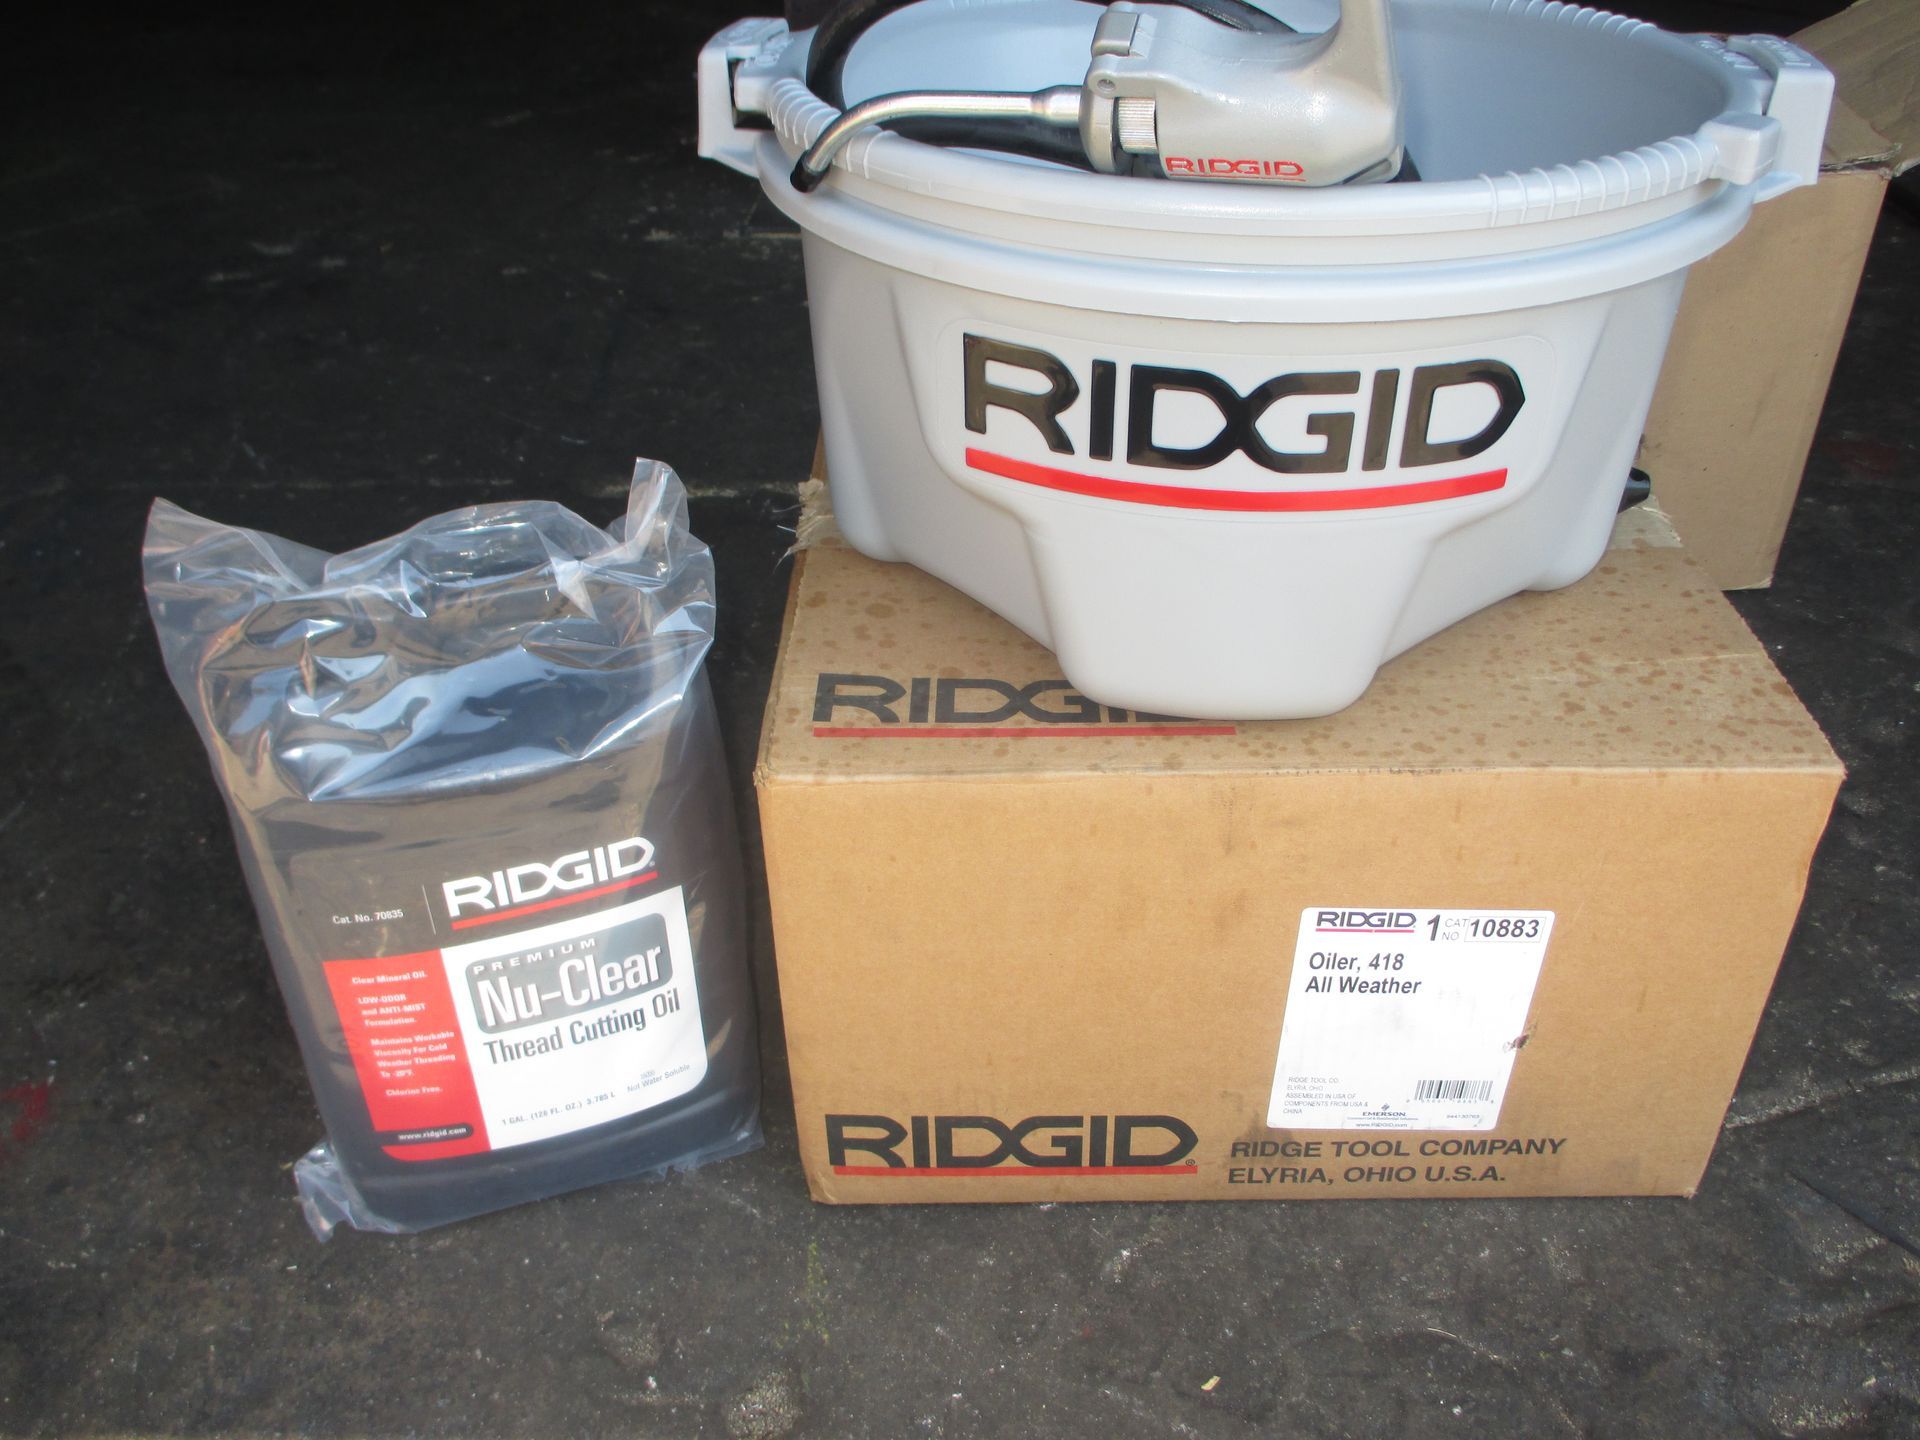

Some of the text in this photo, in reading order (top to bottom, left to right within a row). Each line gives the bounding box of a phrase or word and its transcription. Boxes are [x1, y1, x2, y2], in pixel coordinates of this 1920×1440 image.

[1165, 157, 1304, 178] RIDGID
[963, 332, 1526, 474] RIDGID
[812, 672, 1202, 724] RIDG
[443, 836, 655, 917] RIDGID
[354, 913, 374, 923] No.
[374, 909, 404, 921] 70835
[1316, 911, 1540, 942] RIDGID 1 CAT 10883
[1442, 931, 1460, 941] NO
[473, 938, 597, 975] PREMIUM
[1309, 952, 1405, 973] Oiler, 418
[352, 975, 375, 985] Clear
[376, 973, 411, 984] Mineral
[477, 945, 662, 1027] Nu-Clear
[1305, 976, 1422, 994] All Weather
[358, 993, 407, 1005] LOW-ODOR
[362, 1003, 426, 1016] and ANTI-MIST
[484, 987, 681, 1065] Thread Cutting Oil
[414, 1031, 455, 1043] Workable
[414, 1054, 456, 1066] Threading
[642, 1074, 664, 1089] Water
[665, 1063, 692, 1080] Soluble
[398, 1127, 467, 1141] www.ridgid.com
[824, 1114, 1199, 1168] RIDGID
[1230, 1138, 1567, 1158] RIDGE TOOL COMPANY
[1227, 1165, 1506, 1186] ELYRIA, OHIO U.S.A.
